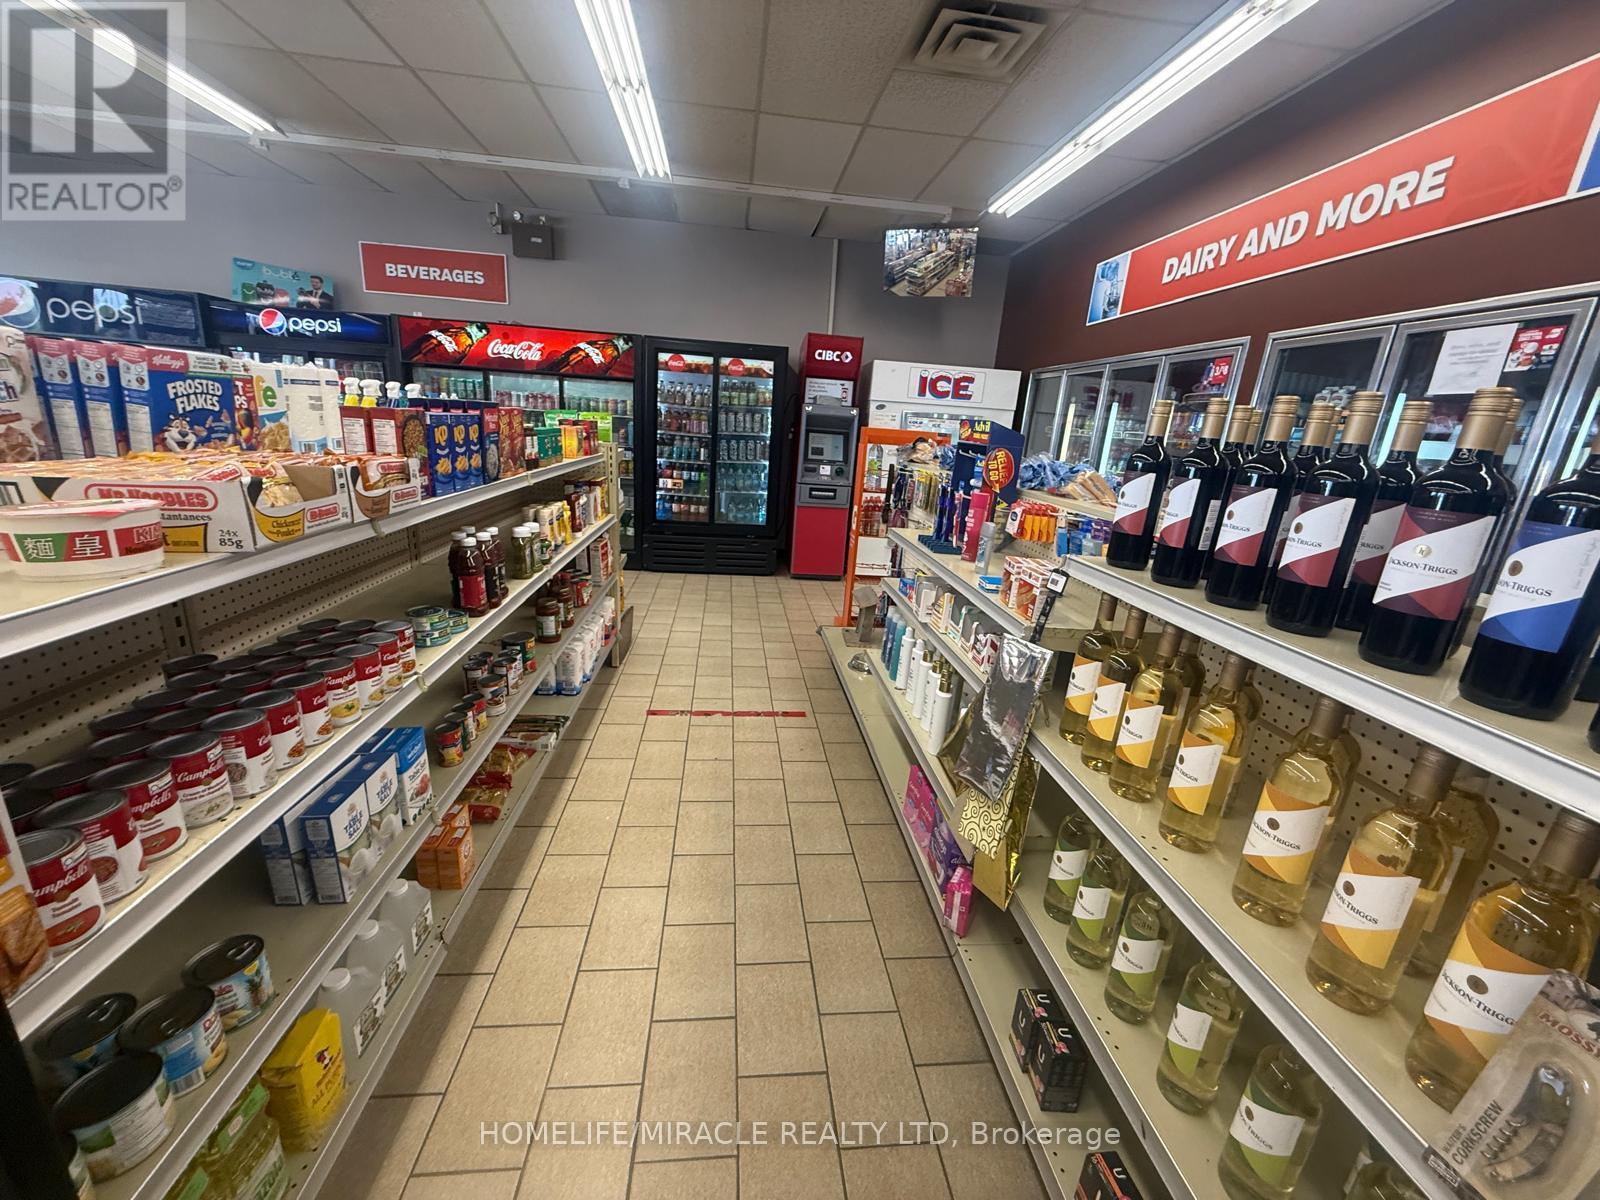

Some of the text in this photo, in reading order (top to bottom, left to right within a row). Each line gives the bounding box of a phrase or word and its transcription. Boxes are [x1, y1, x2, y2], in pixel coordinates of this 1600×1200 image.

[1161, 155, 1455, 284] DAIRY AND MORE
[385, 262, 485, 285] BEVERAGES
[46, 297, 144, 328] pepsi
[289, 317, 342, 334] pepsi
[815, 349, 841, 362] CIBC
[166, 379, 222, 399] FROSTED
[175, 395, 220, 414] FLAKES
[974, 421, 990, 432] Advil
[219, 538, 243, 549] 85g
[376, 779, 393, 799] TABLE
[344, 809, 363, 833] TABLE
[348, 823, 363, 839] SALT
[1452, 1100, 1503, 1165] CORKSCREW
